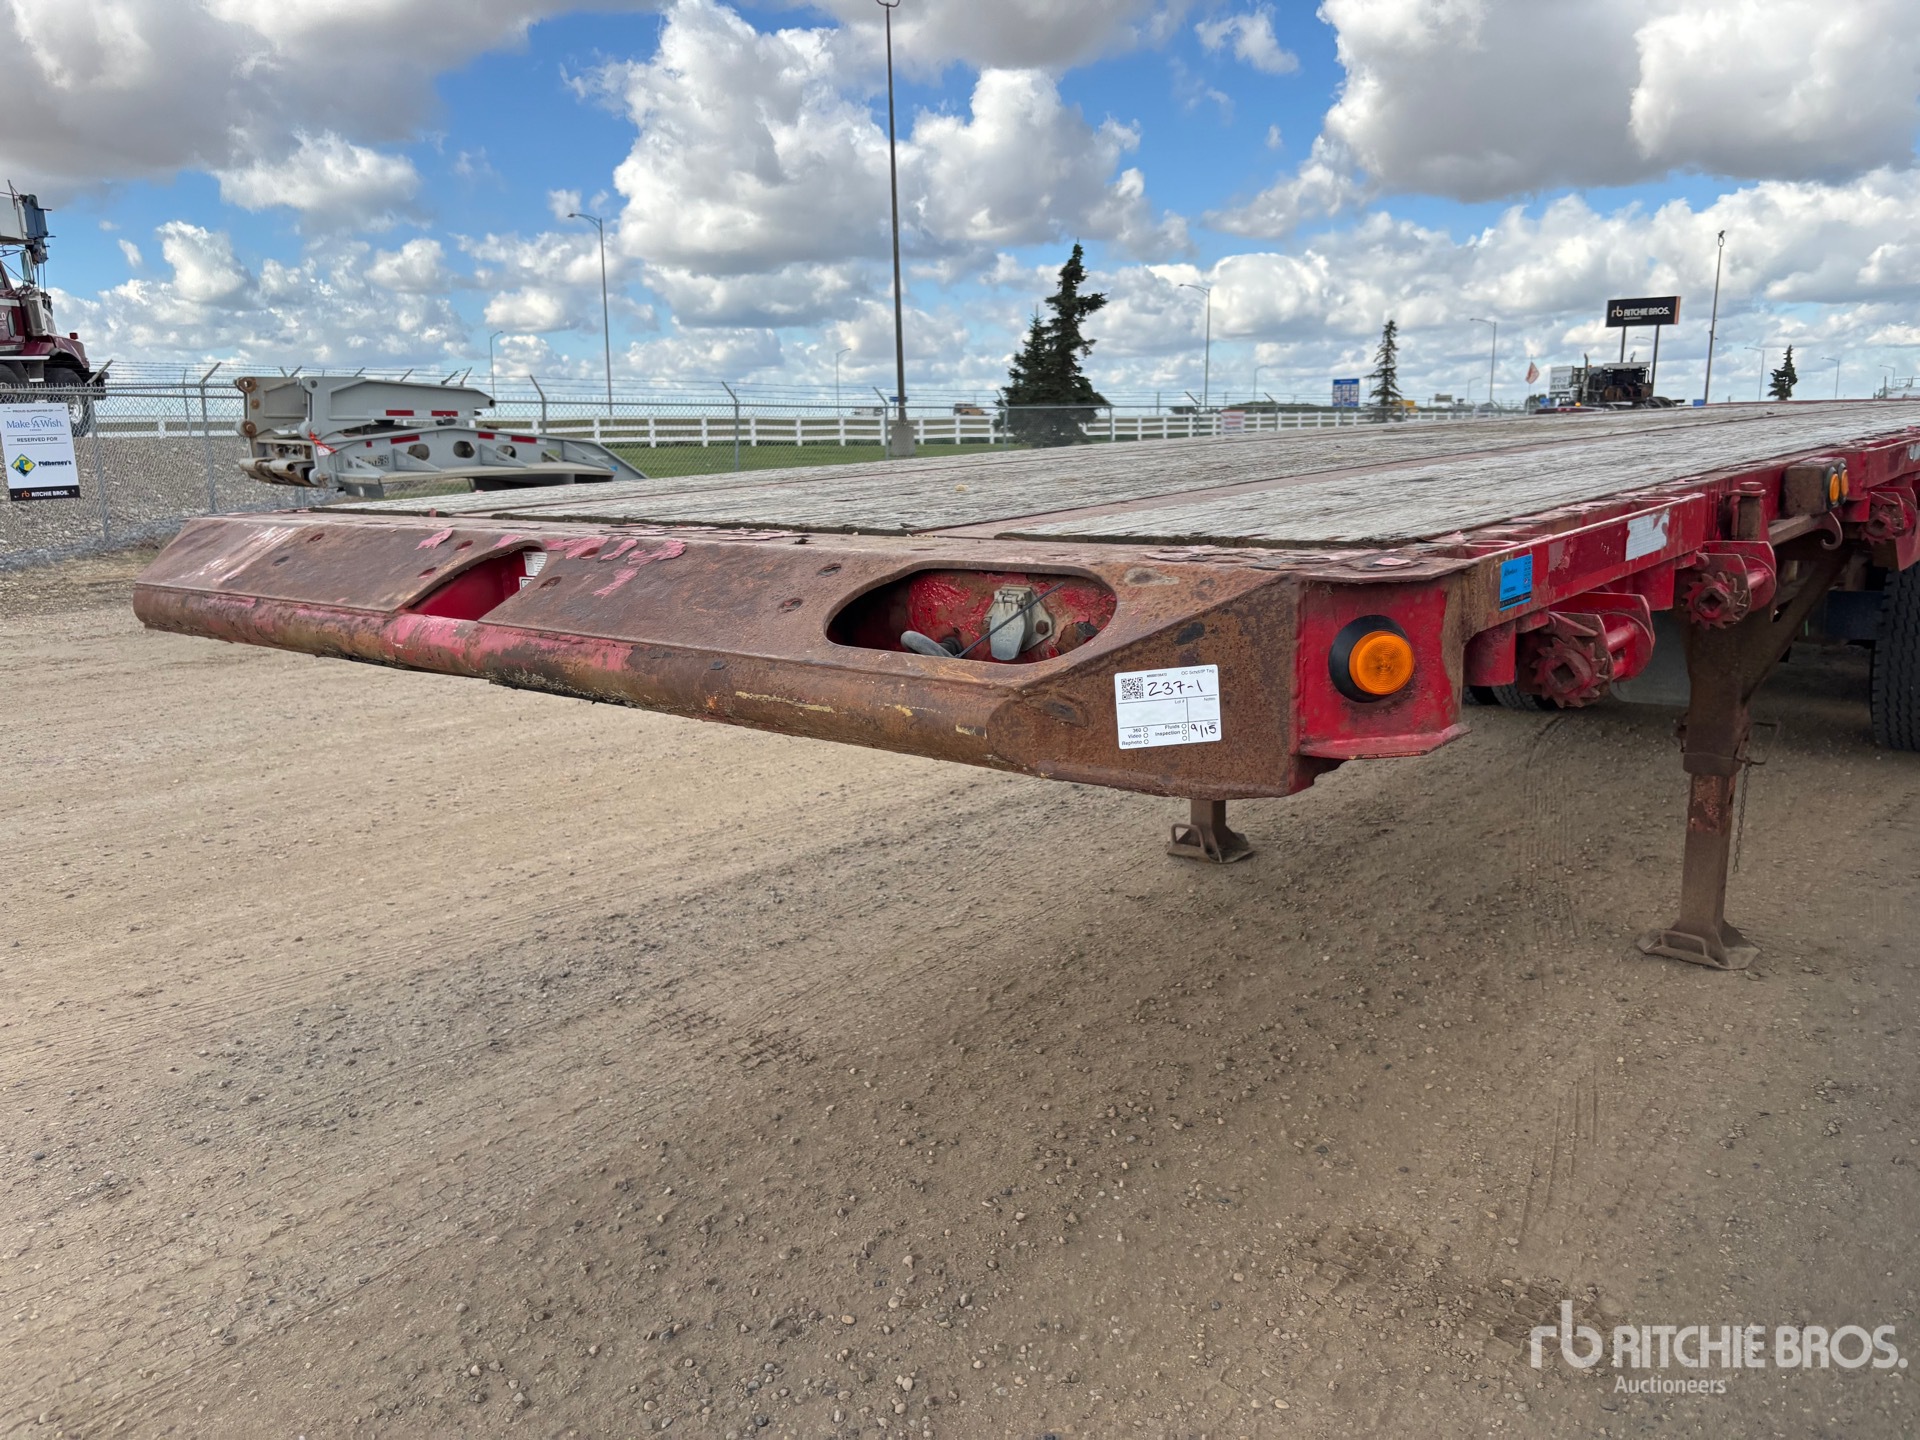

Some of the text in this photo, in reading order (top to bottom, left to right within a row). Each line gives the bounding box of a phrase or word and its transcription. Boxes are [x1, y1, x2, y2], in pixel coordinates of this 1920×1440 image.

[1611, 306, 1670, 317] rb RITCHIE BROS.
[21, 490, 30, 498] rb
[1147, 680, 1203, 697] 237-1
[1190, 723, 1217, 738] 9/15
